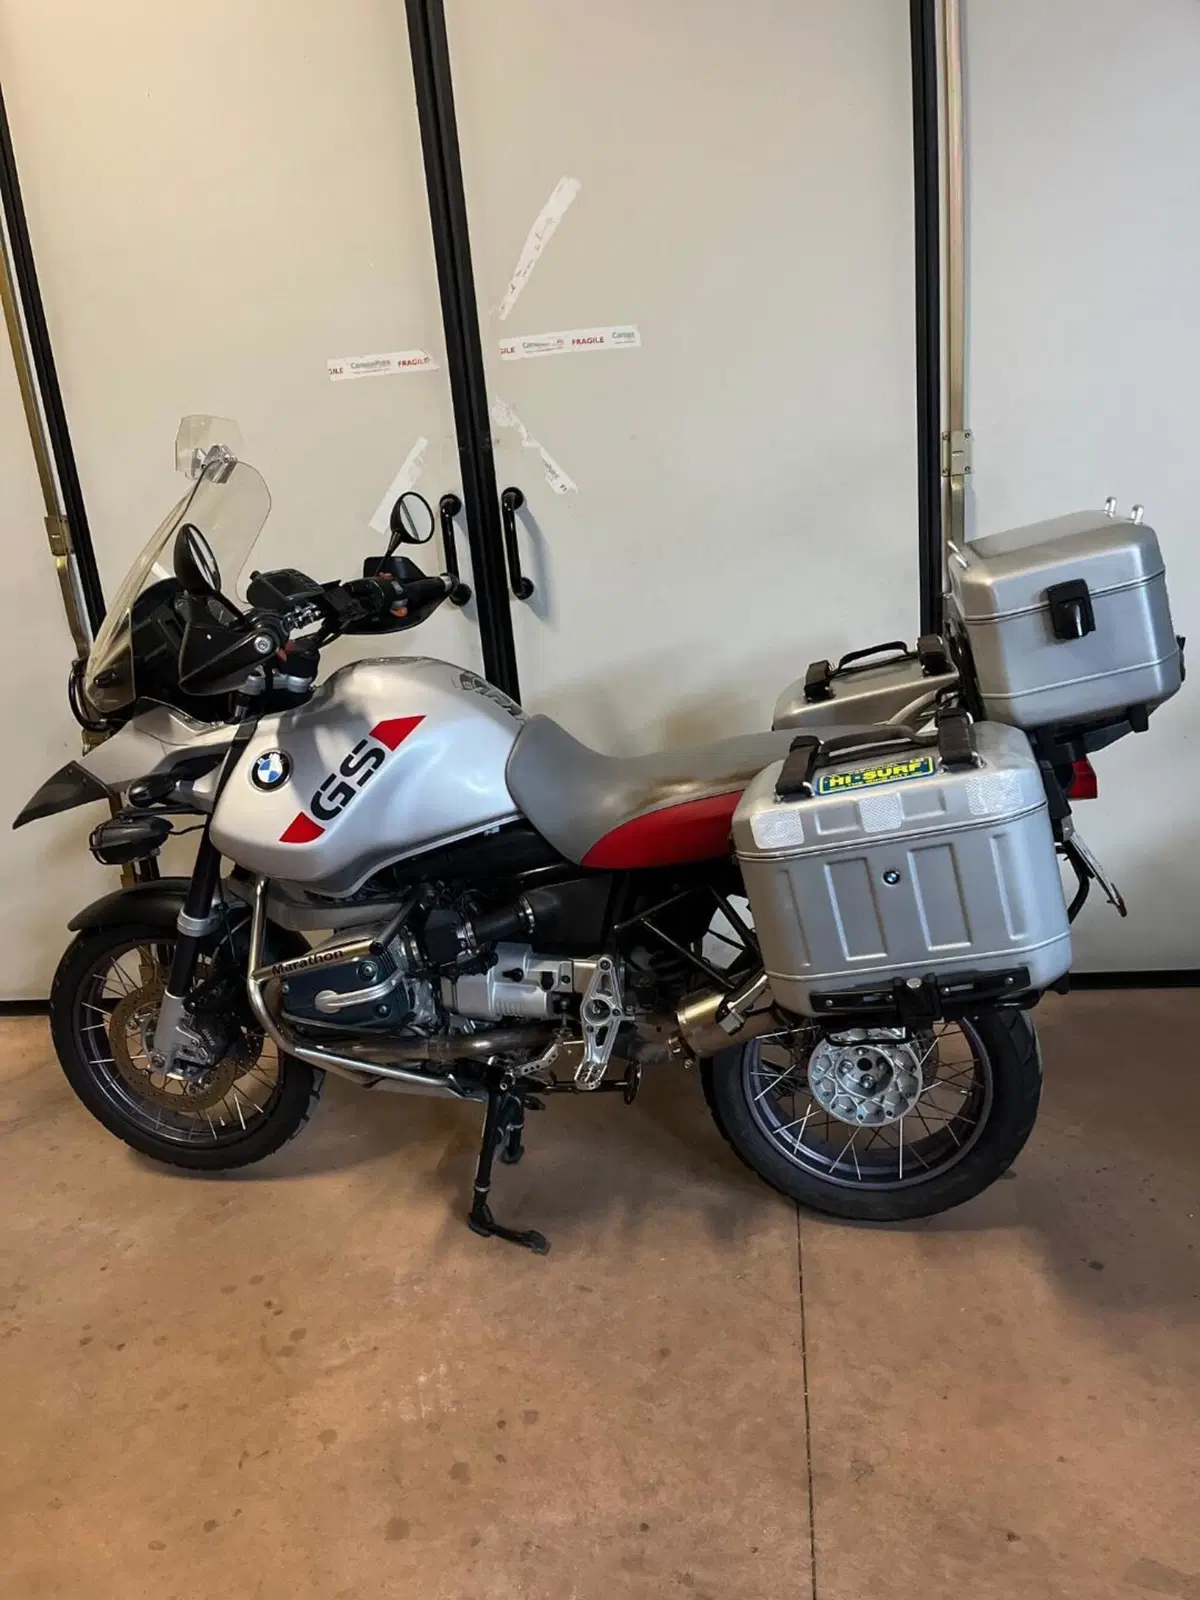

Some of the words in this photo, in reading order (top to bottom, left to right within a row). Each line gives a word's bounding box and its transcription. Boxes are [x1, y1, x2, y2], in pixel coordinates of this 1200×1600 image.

[571, 336, 604, 345] FRAGILE
[398, 357, 429, 366] FRAGILE
[310, 738, 386, 821] GS
[271, 950, 344, 975] Marathon
